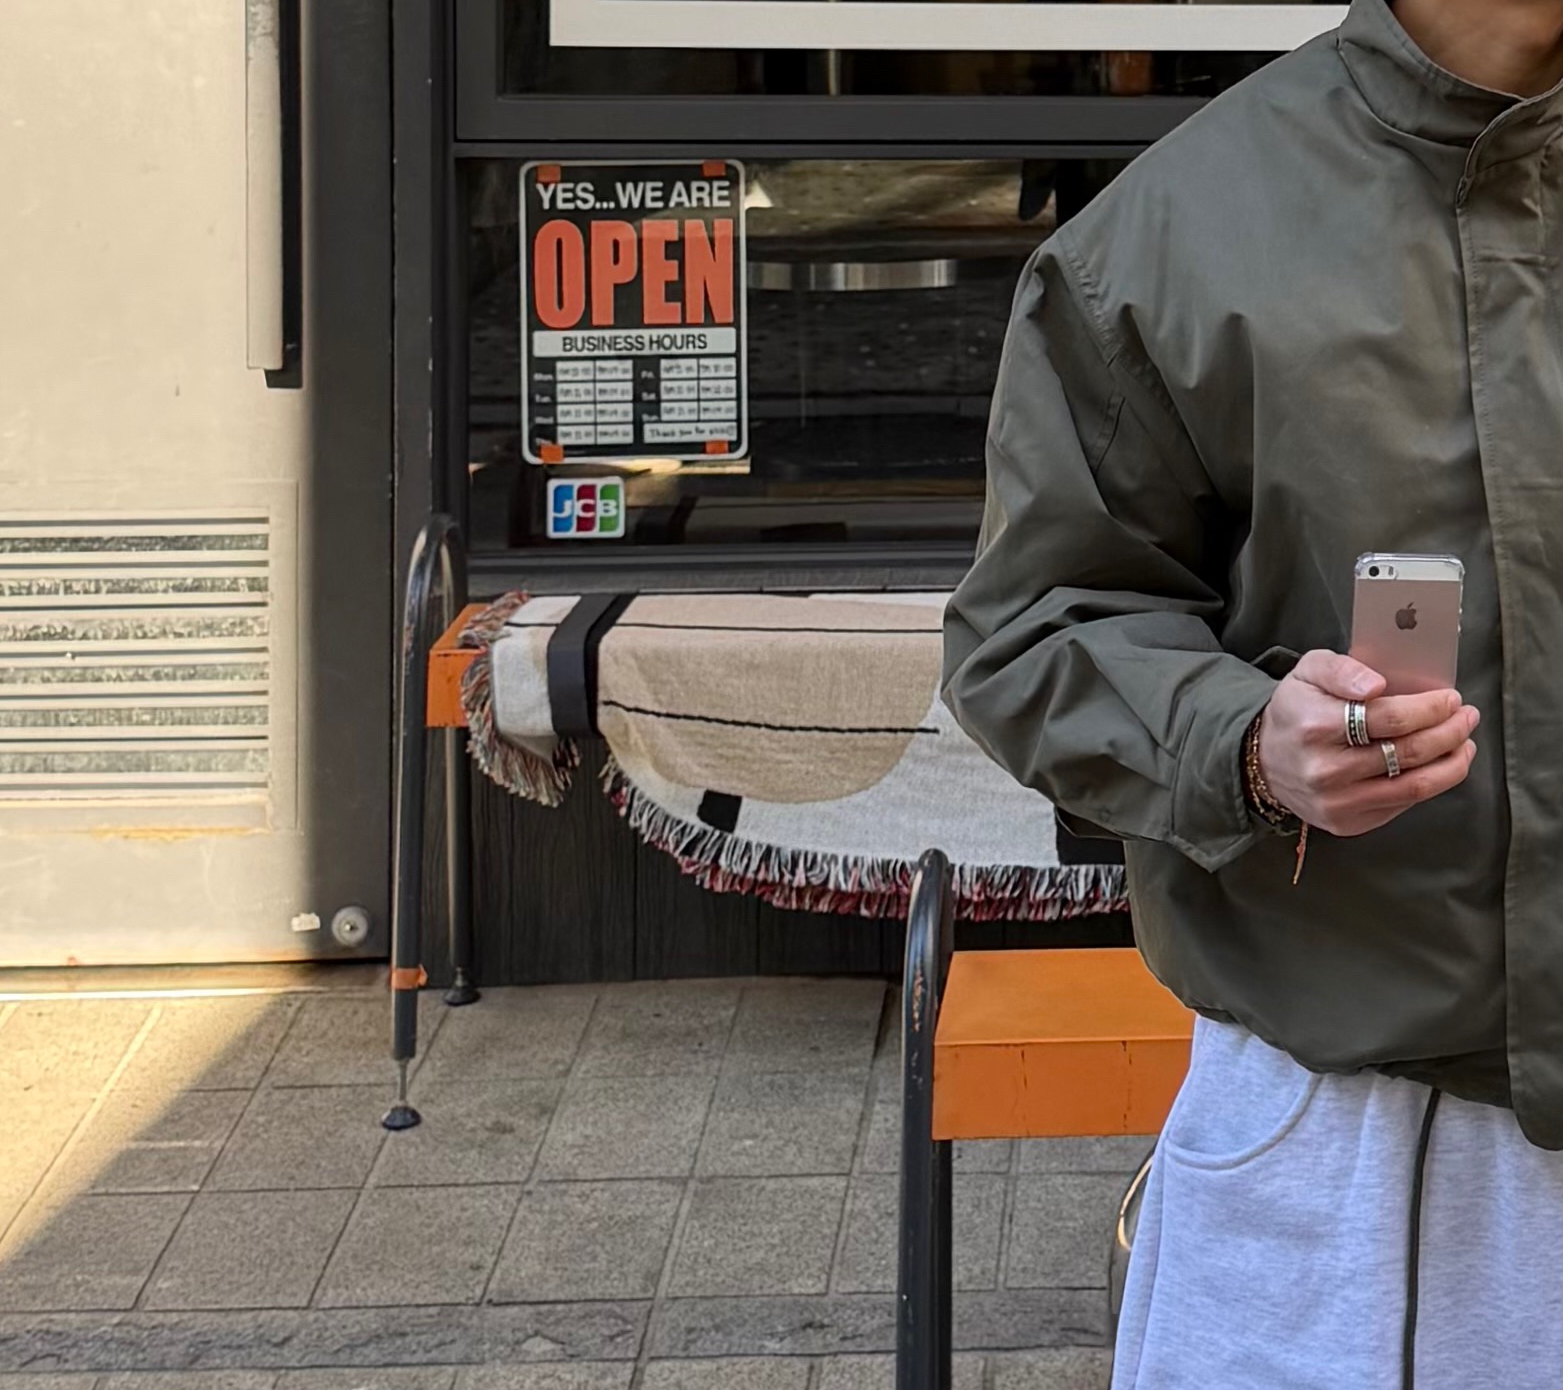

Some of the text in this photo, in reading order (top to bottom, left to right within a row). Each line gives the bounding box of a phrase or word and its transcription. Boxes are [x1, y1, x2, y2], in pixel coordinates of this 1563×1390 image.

[669, 181, 730, 208] ARE
[534, 218, 734, 329] OPEN
[562, 334, 708, 353] BUSINESS HOURS
[552, 497, 619, 519] JCB
